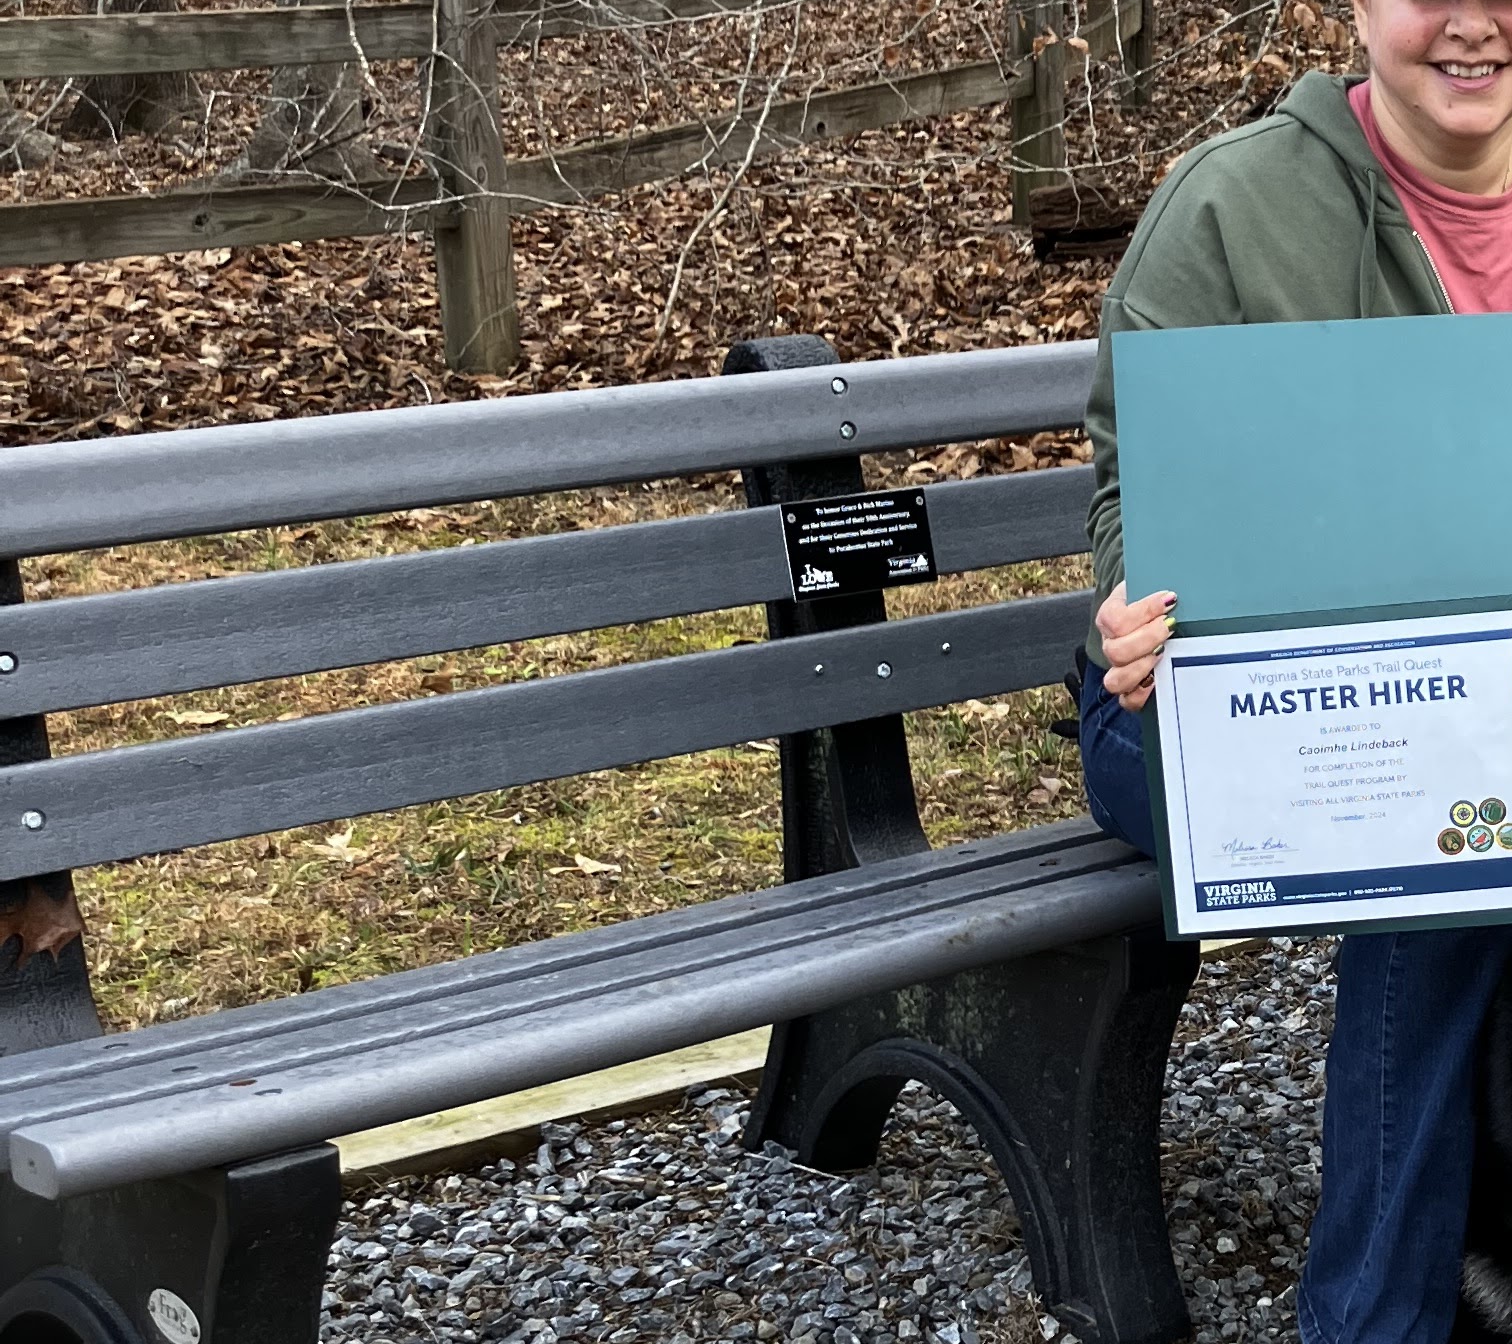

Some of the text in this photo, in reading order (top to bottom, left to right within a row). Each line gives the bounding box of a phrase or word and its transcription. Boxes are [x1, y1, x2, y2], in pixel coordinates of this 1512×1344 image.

[1248, 657, 1443, 686] Virginia State Parks Trail Quest
[1230, 674, 1468, 718] MASTER HIKER
[1328, 724, 1368, 734] AWARDED
[1298, 743, 1348, 756] Caoimhe
[1304, 758, 1404, 773] FOR COMPLETION OF THE
[1328, 778, 1354, 788] QUEST
[1356, 775, 1395, 785] PROGRAM
[1290, 790, 1426, 808] VISITING ALL VIRGINIA STATE PARKS
[1204, 881, 1276, 897] VIRGINIA
[1206, 892, 1277, 907] STATE PARKS
